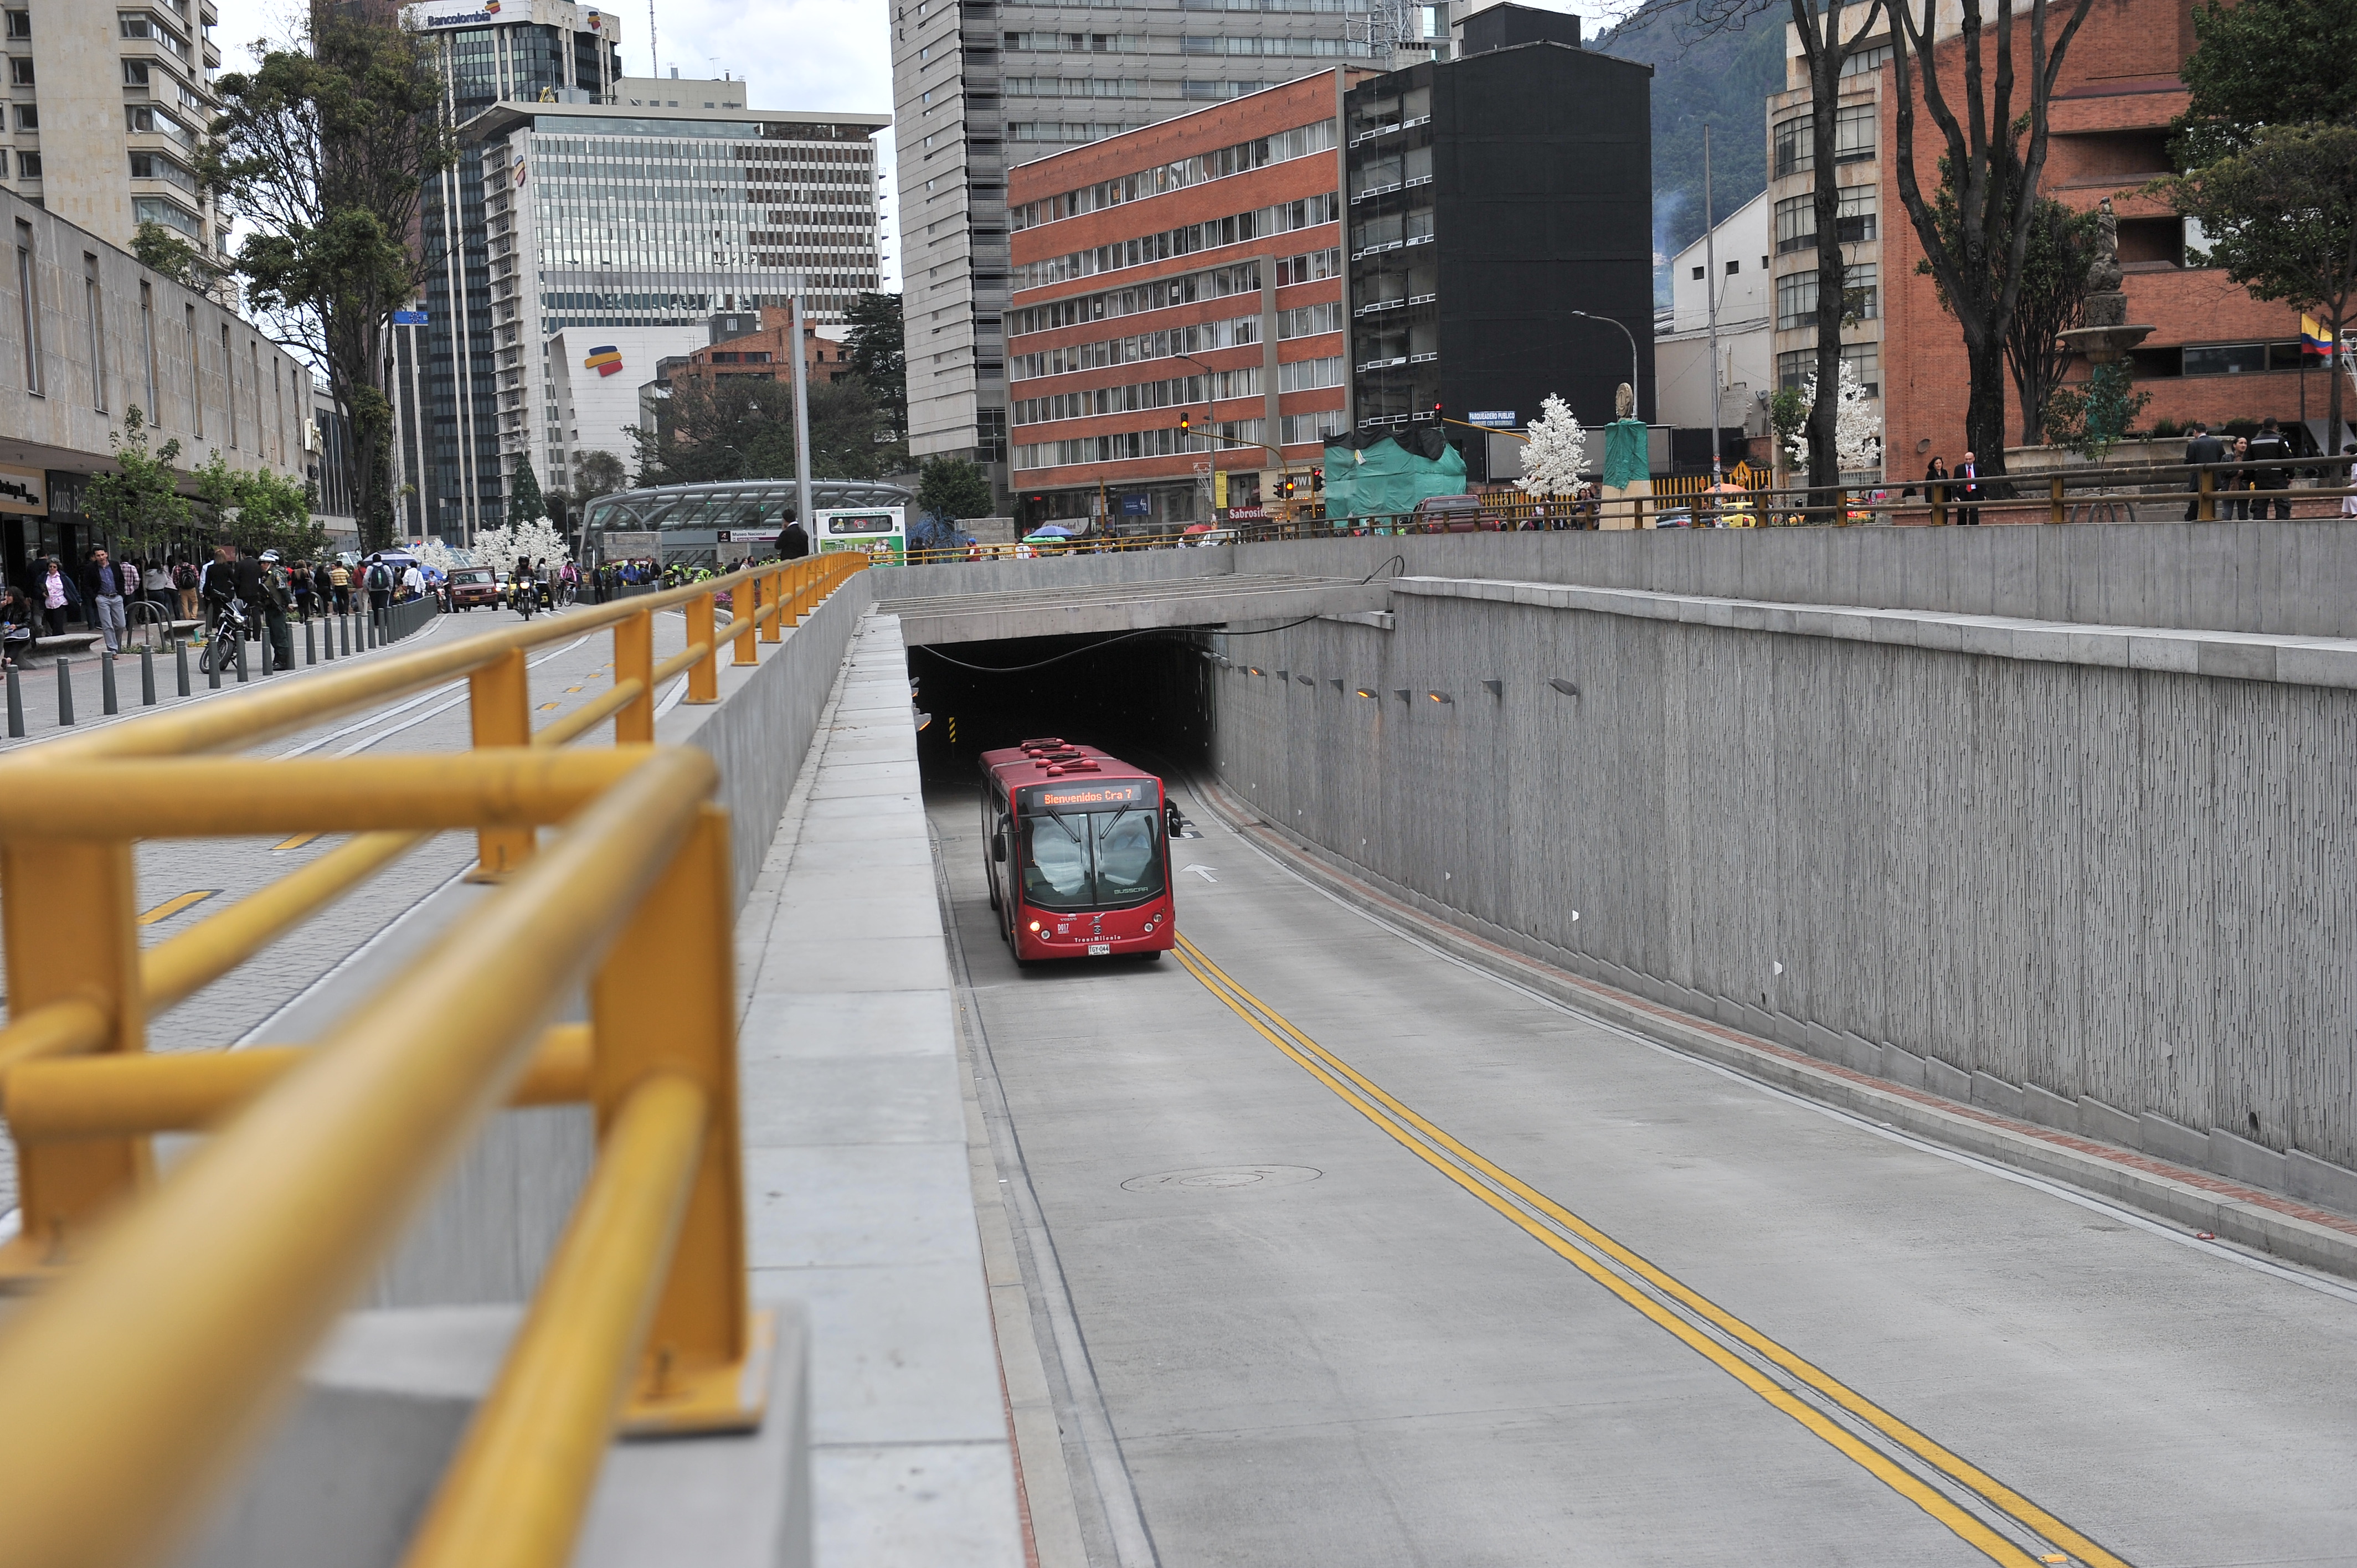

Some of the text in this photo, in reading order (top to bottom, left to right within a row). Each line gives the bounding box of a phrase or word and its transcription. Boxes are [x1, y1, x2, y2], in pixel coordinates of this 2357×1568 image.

[428, 9, 491, 26] Bancolombia
[50, 481, 70, 513] Louis
[1044, 788, 1132, 804] Bienvenidos Cra 7
[1074, 935, 1121, 943] TransMilenio
